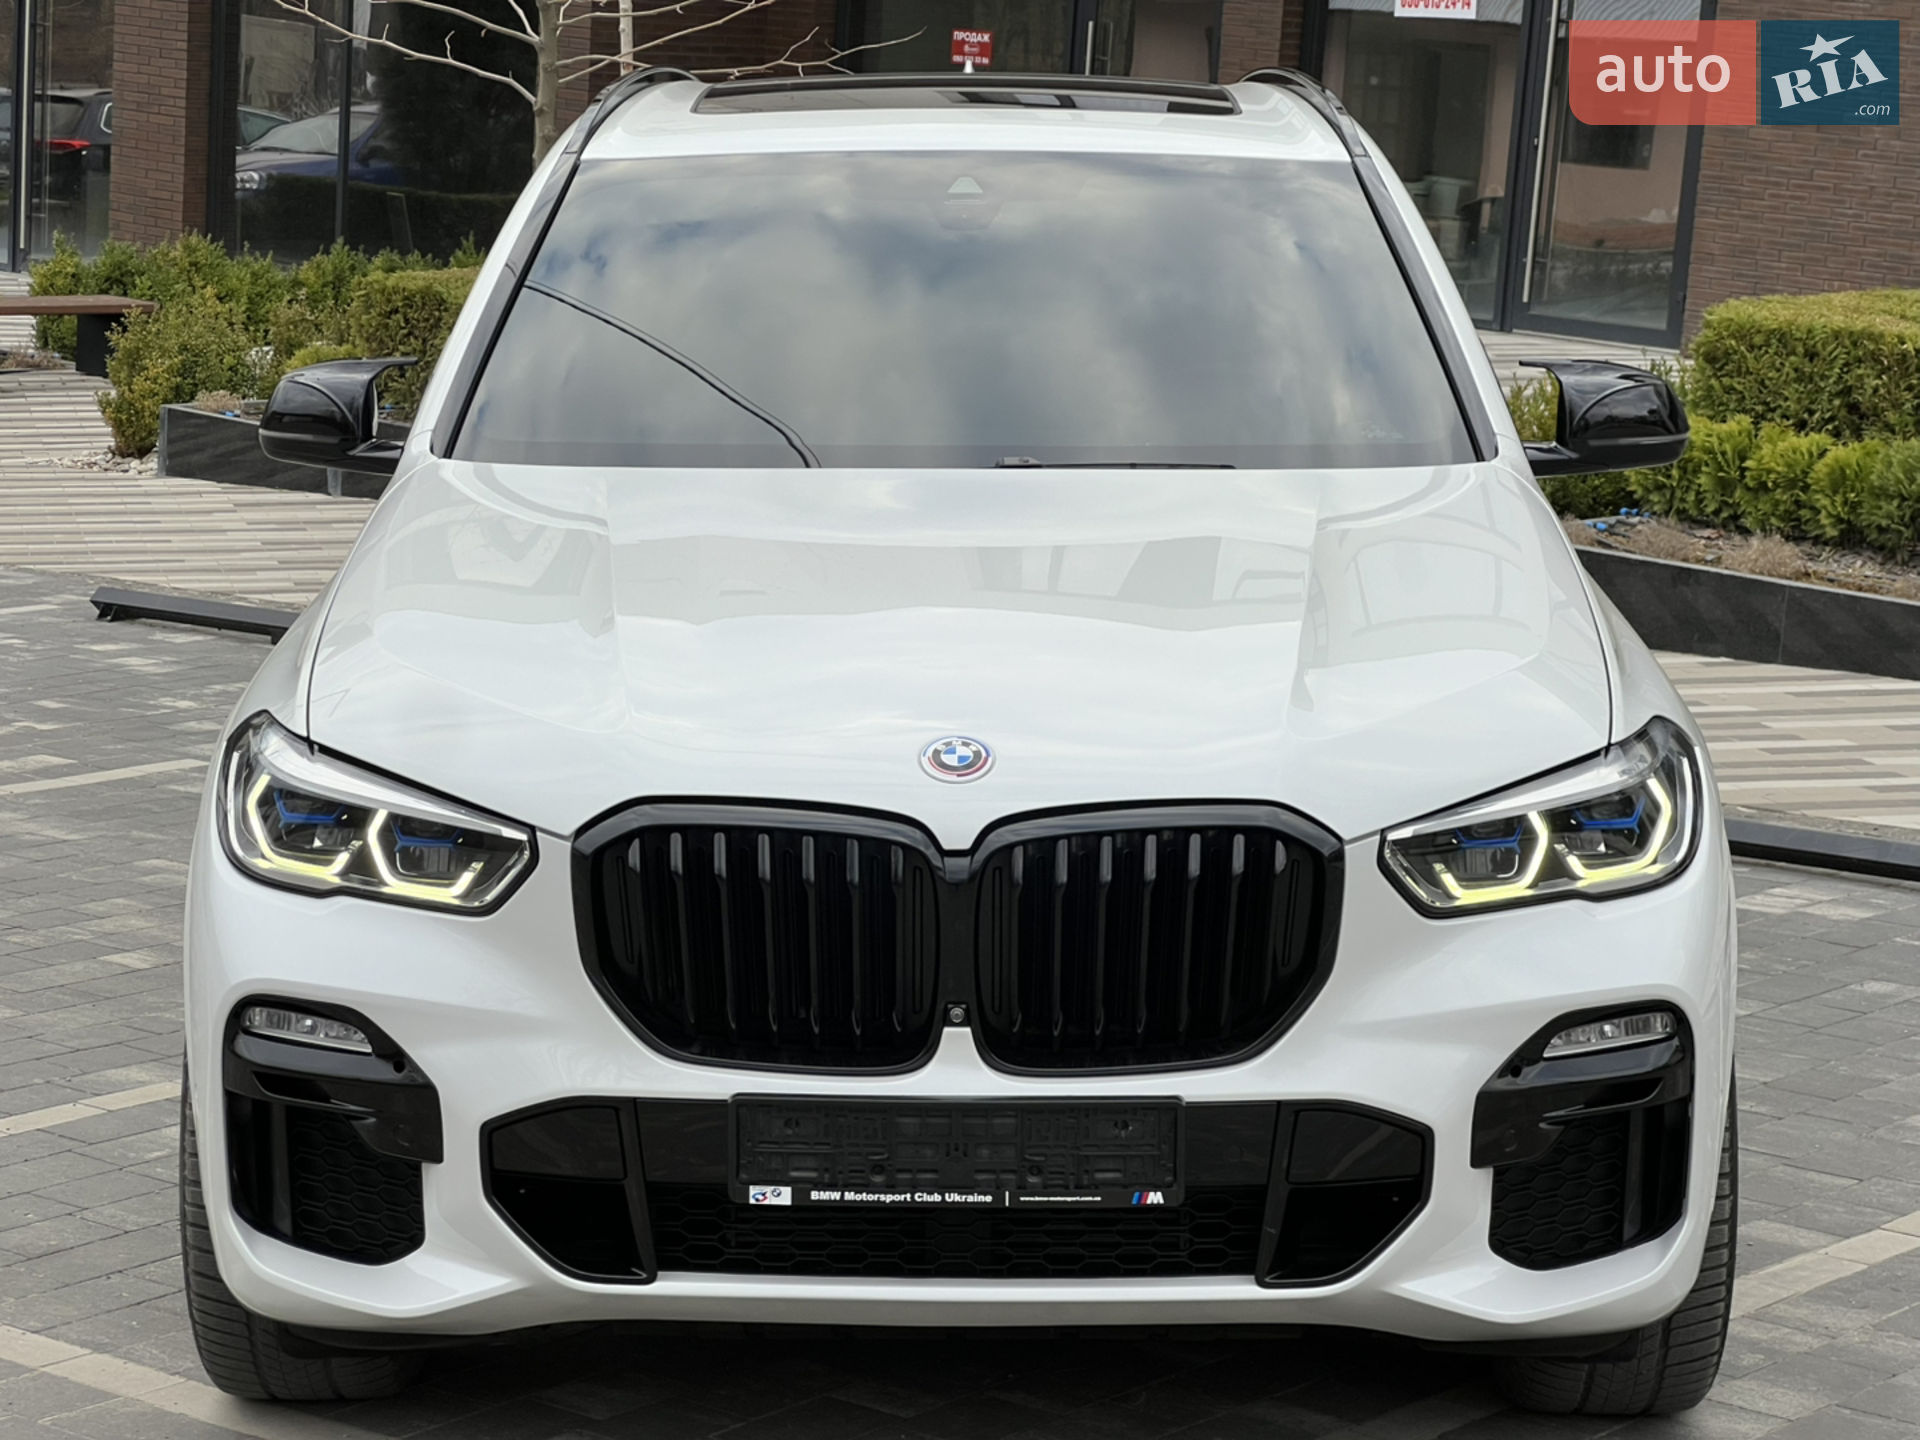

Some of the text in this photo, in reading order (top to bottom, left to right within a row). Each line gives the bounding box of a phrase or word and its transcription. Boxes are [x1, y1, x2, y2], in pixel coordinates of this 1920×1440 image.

[953, 31, 990, 43] ПРОДАЖ
[935, 740, 979, 752] BMW
[810, 1190, 993, 1203] BMW Motorsport Club Ukraine
